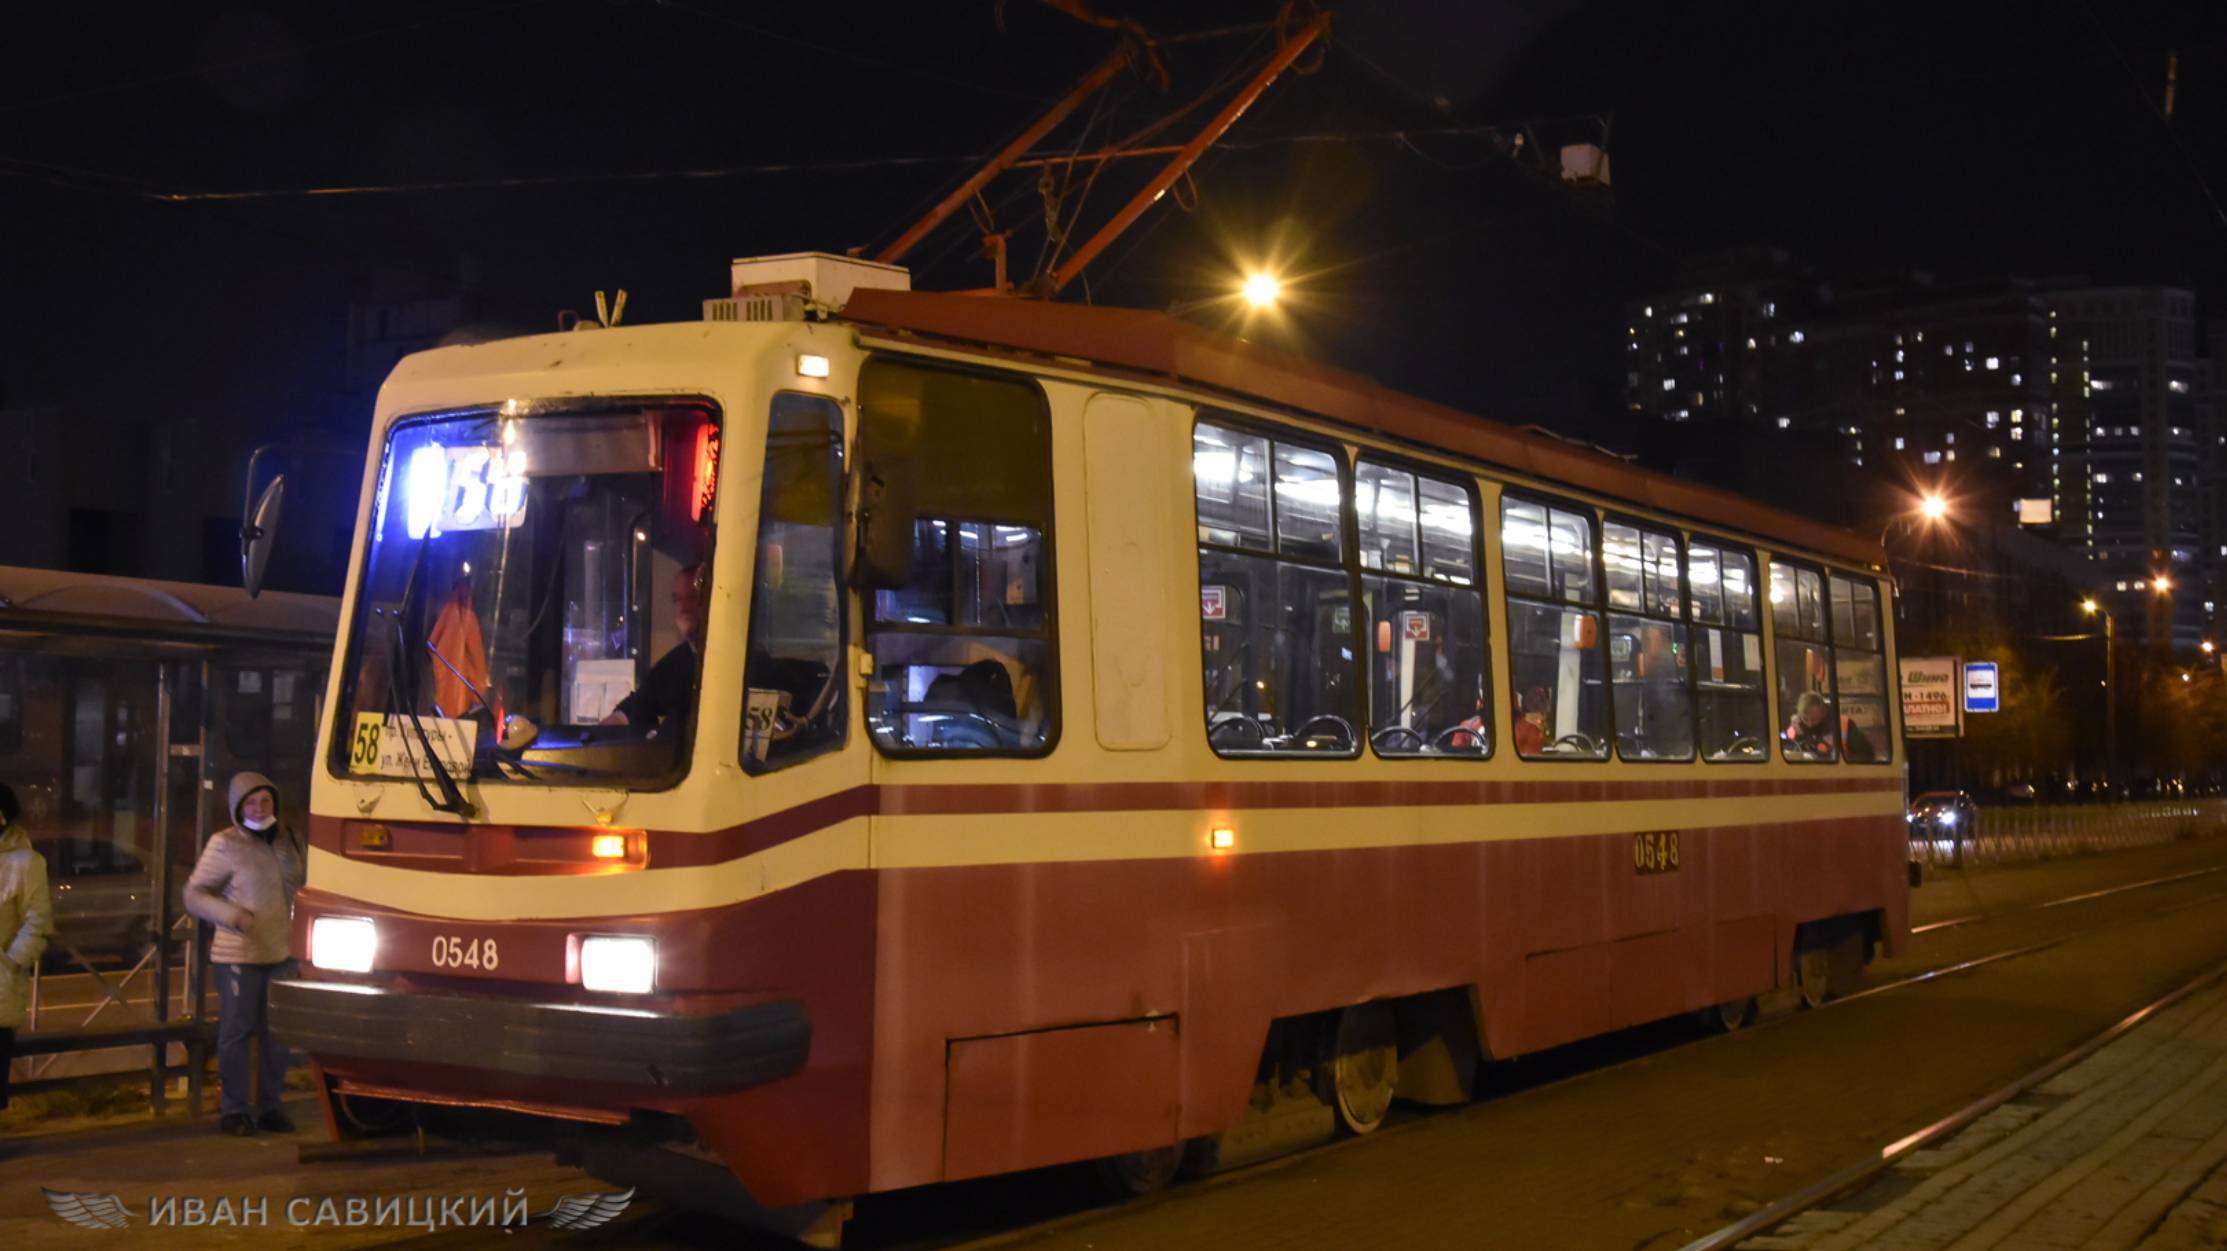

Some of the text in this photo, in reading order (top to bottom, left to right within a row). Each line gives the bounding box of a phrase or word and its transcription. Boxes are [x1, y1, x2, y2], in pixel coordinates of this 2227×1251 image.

[354, 723, 380, 765] 58
[1634, 832, 1680, 871] 0548
[432, 936, 499, 971] 0548
